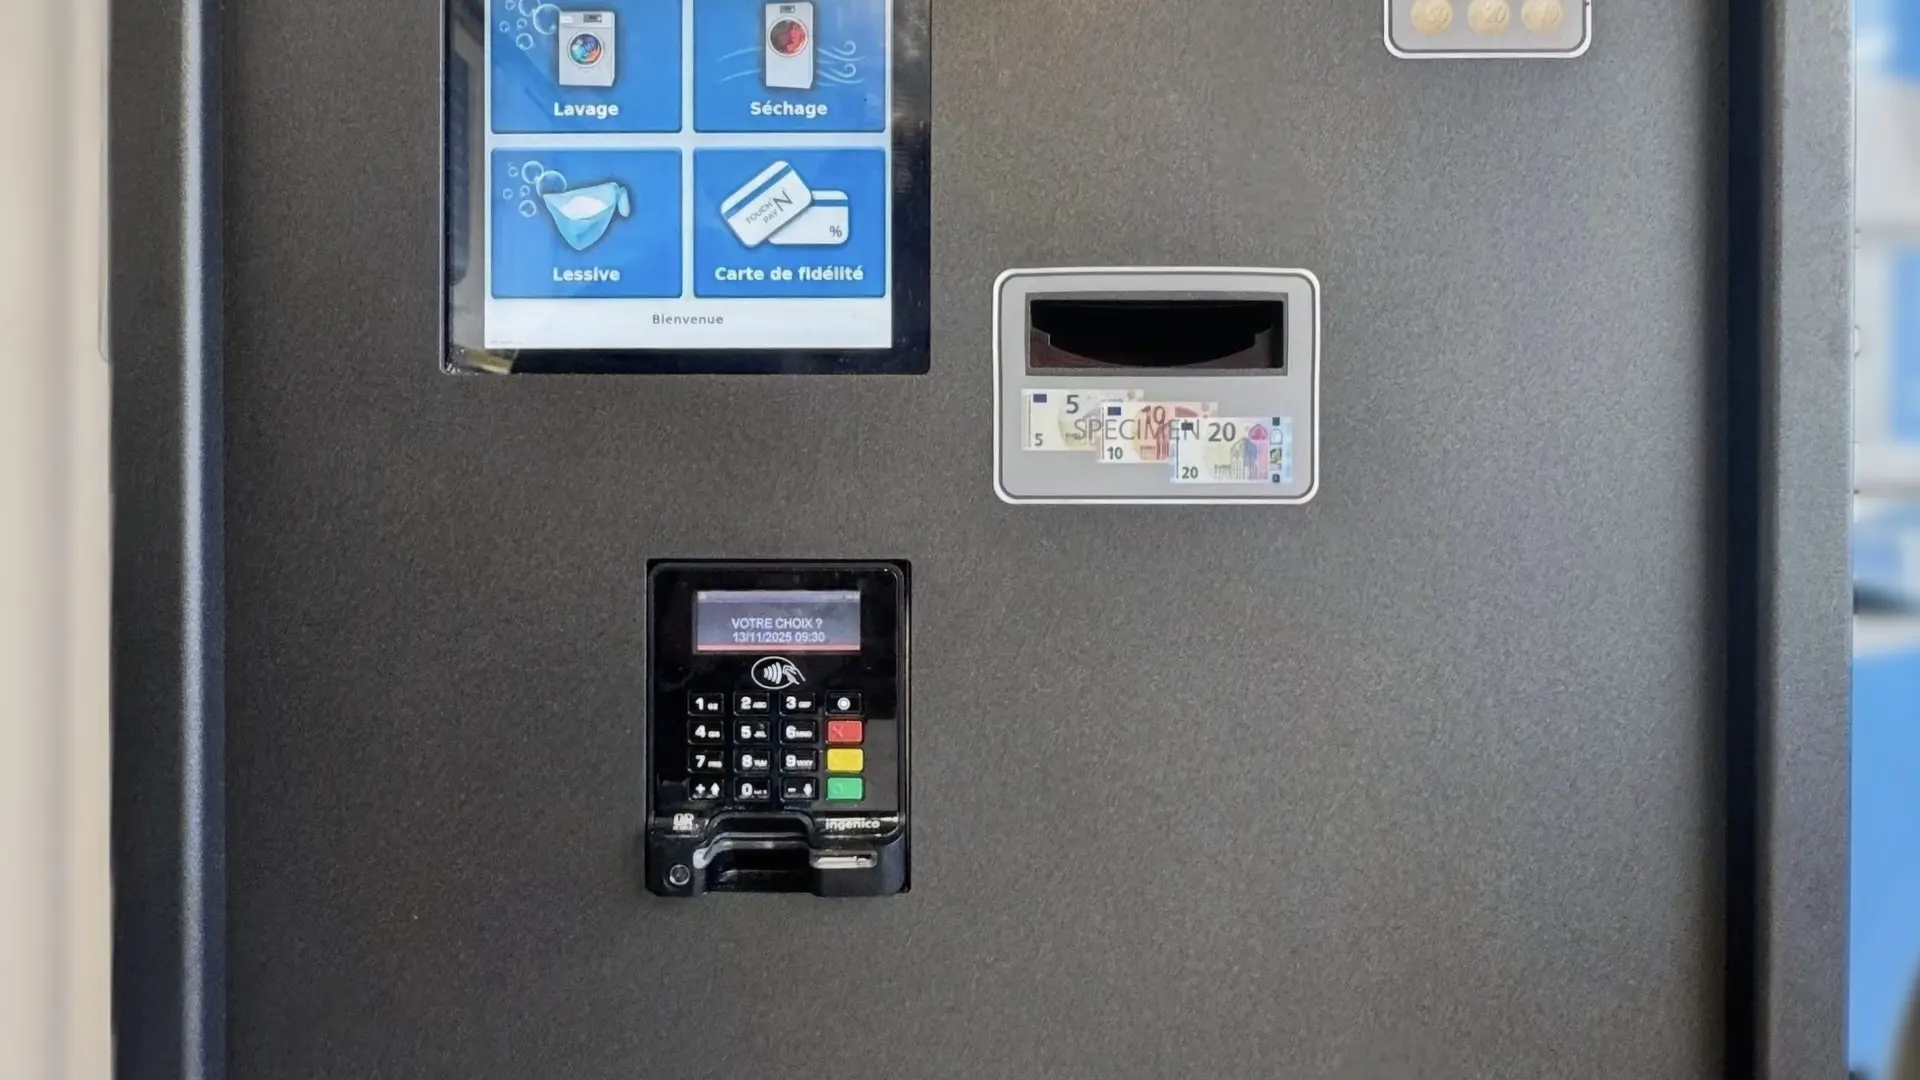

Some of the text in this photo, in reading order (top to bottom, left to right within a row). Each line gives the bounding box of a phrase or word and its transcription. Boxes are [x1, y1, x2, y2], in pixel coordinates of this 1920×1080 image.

[553, 101, 619, 121] Lavage
[749, 100, 828, 120] Séchage
[762, 209, 778, 224] PAY
[553, 267, 620, 282] Lessive
[714, 265, 864, 282] Carte de fidélité
[652, 313, 724, 325] Bienvenue
[1065, 394, 1079, 414] 5
[1141, 405, 1166, 426] 10
[1074, 418, 1200, 441] SPECIMEN
[1208, 422, 1236, 442] 20
[1034, 433, 1044, 446] 5
[1107, 446, 1123, 460] 10
[1181, 466, 1198, 479] 20
[731, 617, 823, 629] VOTRE CHOIX ?
[732, 631, 826, 643] 13/11/2025 09:30
[695, 697, 705, 711] 1
[740, 696, 752, 710] 2
[785, 696, 797, 710] 3
[695, 725, 706, 738] 4
[740, 725, 752, 739] 5
[785, 725, 797, 740] 6
[695, 754, 706, 768] 7
[741, 754, 753, 768] 8
[785, 754, 797, 767] 9
[741, 782, 753, 796] 0
[825, 816, 880, 831] ingenico
